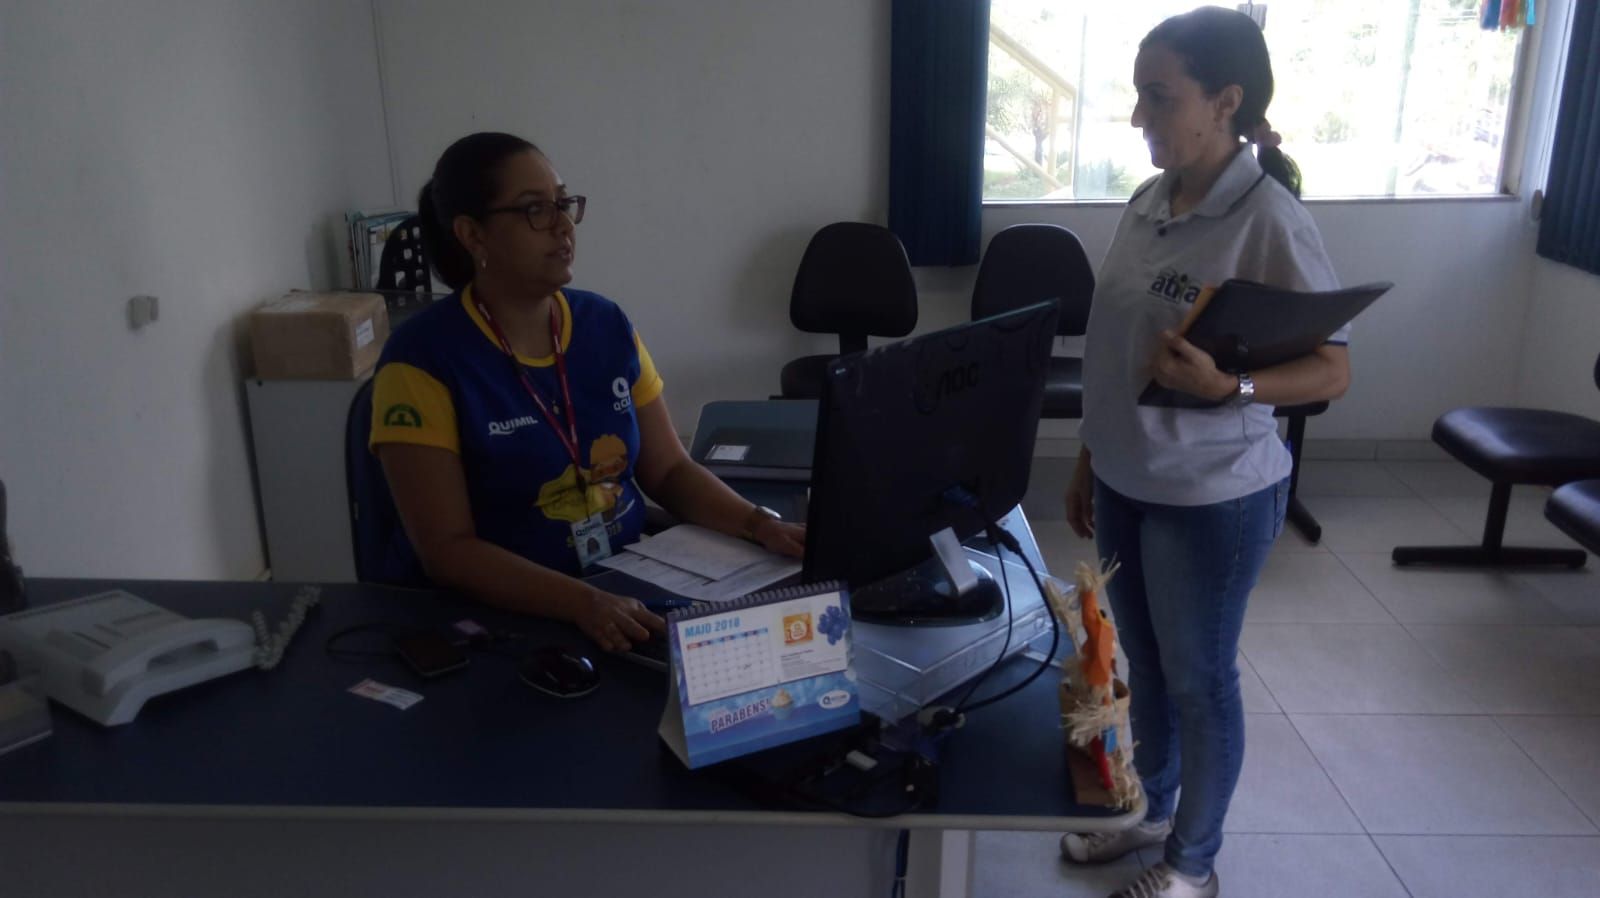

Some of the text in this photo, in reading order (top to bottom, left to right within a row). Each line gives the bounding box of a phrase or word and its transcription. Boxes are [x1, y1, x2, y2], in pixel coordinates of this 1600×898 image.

[488, 415, 538, 435] QUIMIL
[684, 616, 741, 639] MAIO 2018
